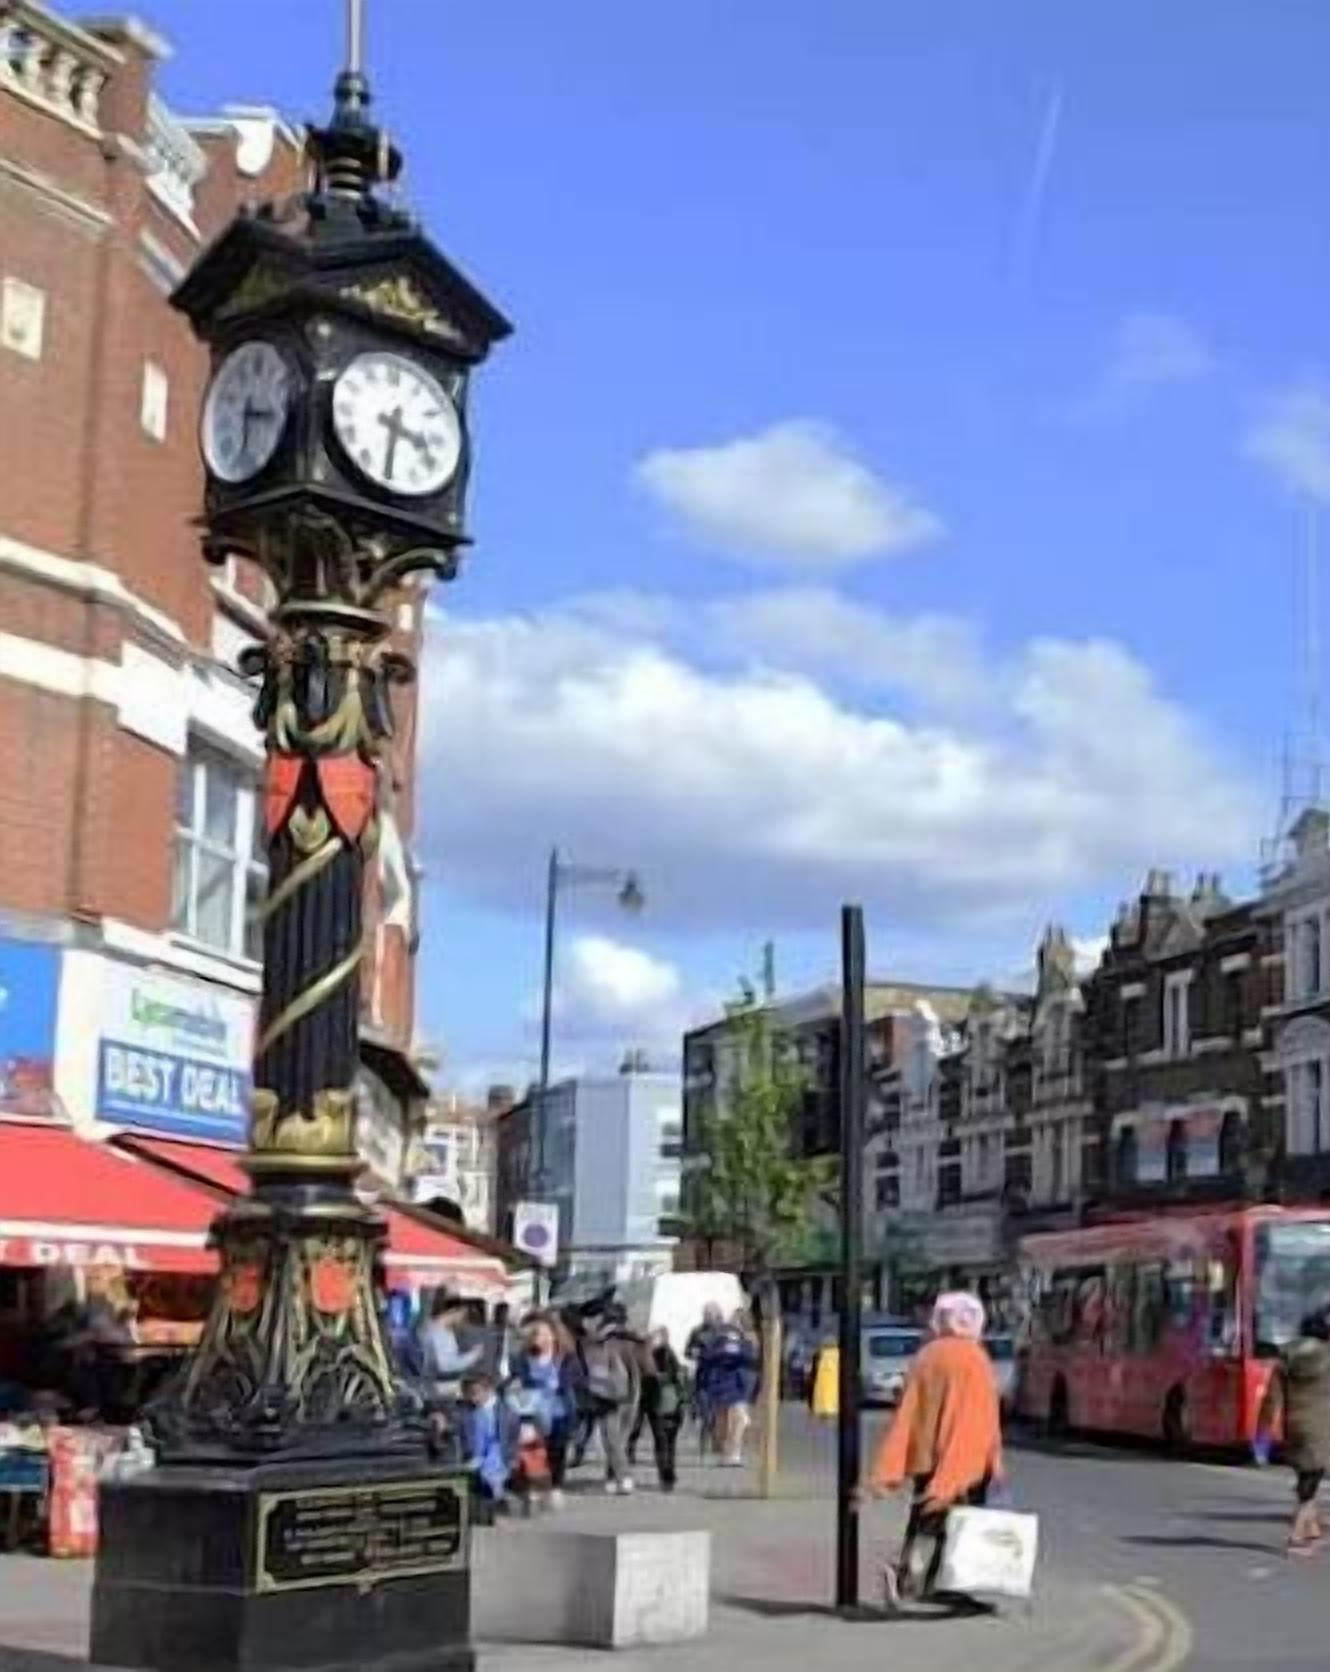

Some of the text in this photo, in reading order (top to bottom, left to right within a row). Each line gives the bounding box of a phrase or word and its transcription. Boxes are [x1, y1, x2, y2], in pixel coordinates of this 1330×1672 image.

[105, 1046, 177, 1104] BEST
[179, 1061, 245, 1119] DEAL
[31, 1241, 145, 1272] DEAL
